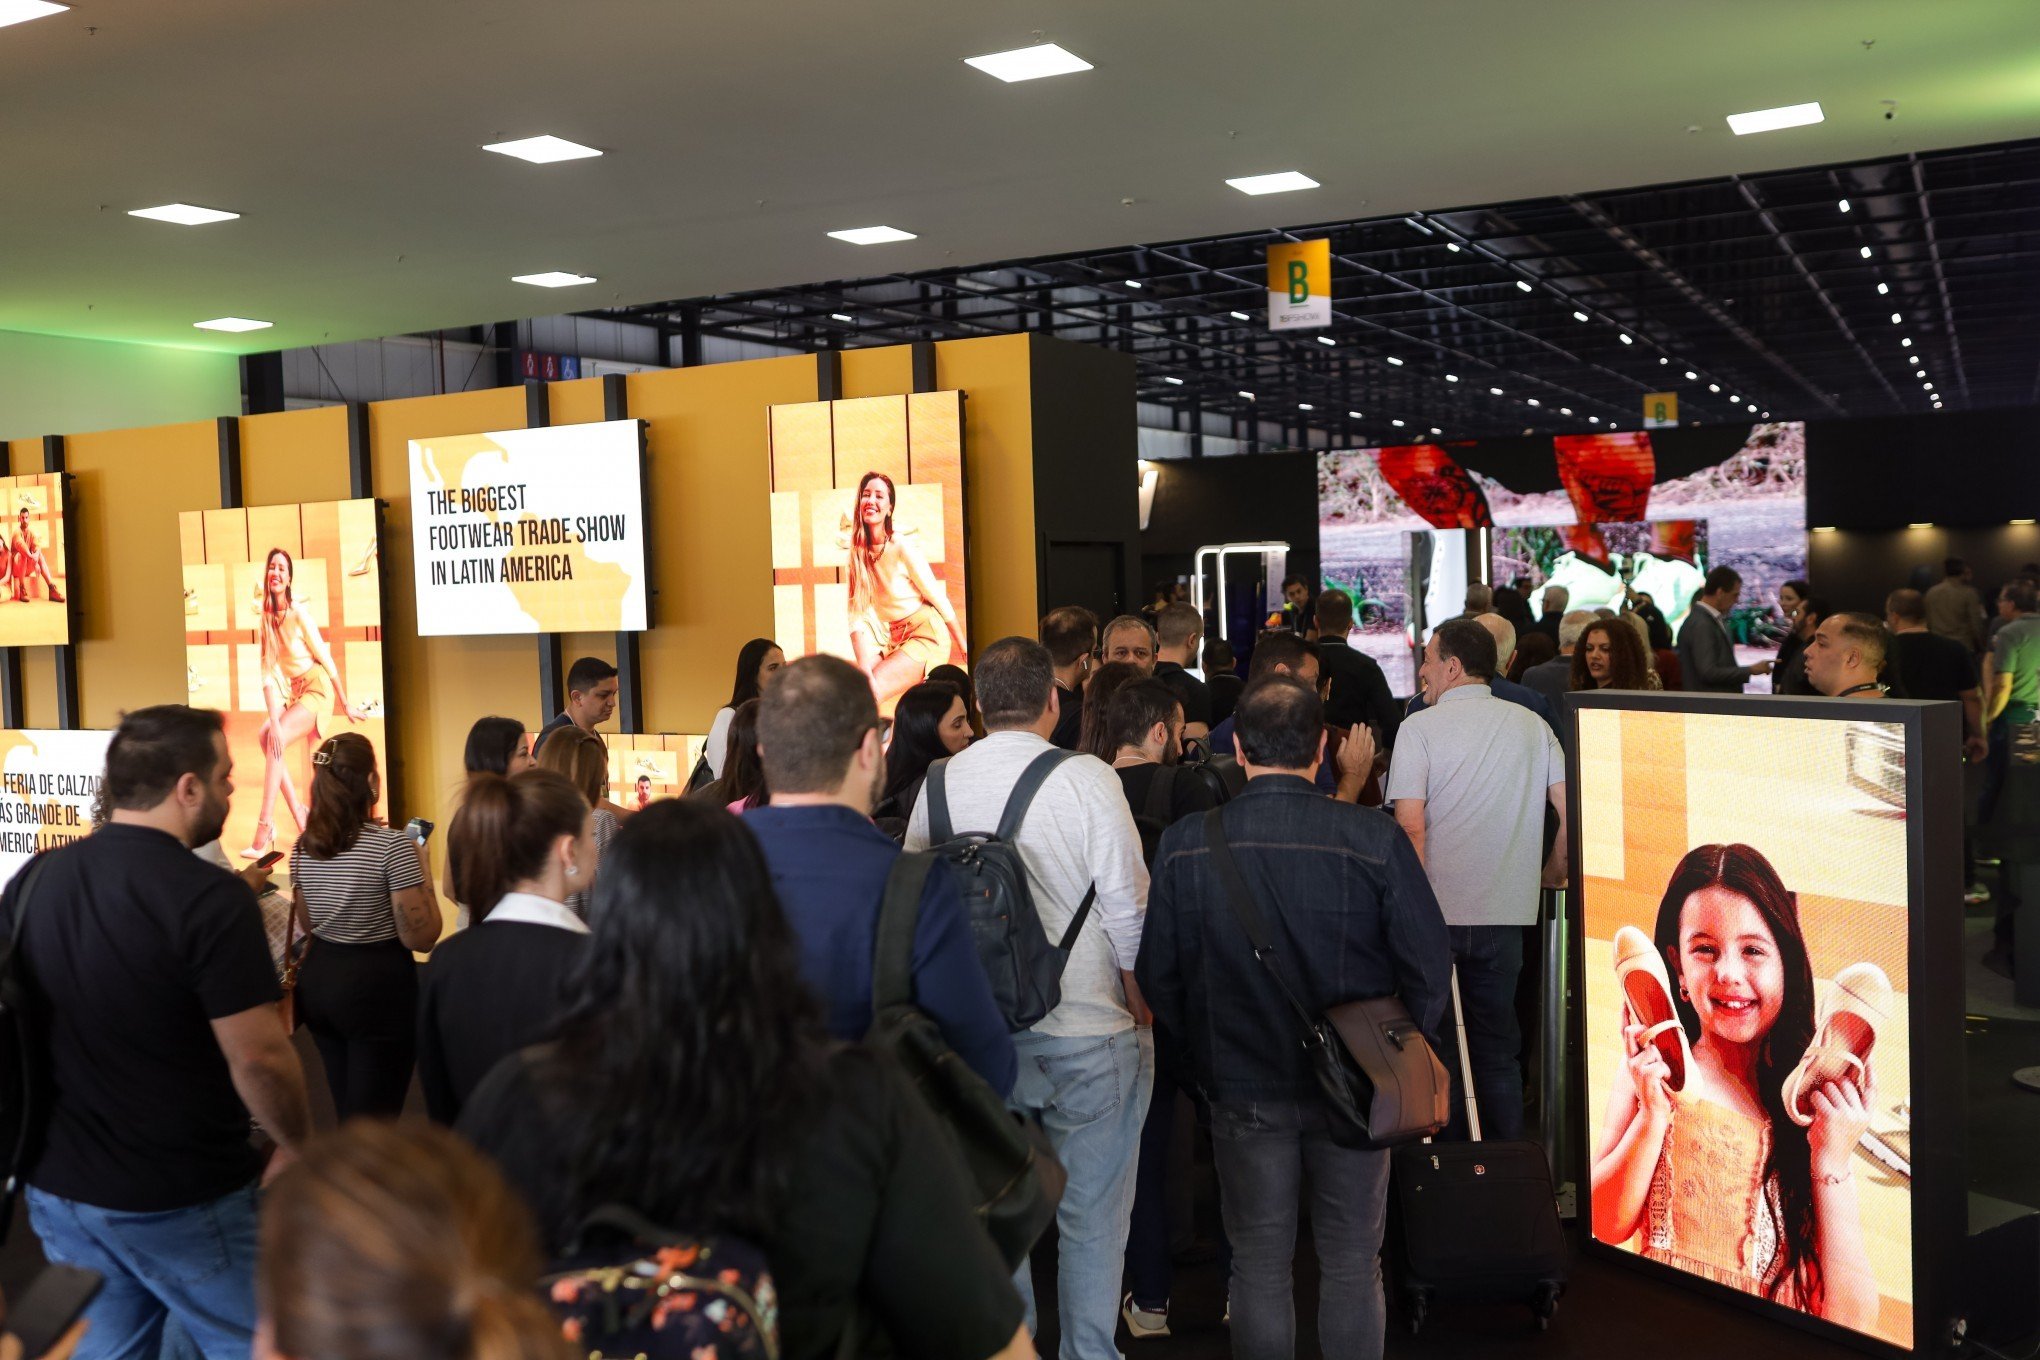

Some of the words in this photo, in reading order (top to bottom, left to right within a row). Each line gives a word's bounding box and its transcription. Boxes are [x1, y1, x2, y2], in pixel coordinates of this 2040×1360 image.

[1289, 260, 1309, 304] B
[427, 489, 457, 515] THE
[461, 484, 527, 513] BIGGEST
[430, 521, 514, 550] FOOTWEAR
[517, 518, 571, 546] TRADE
[576, 514, 625, 543] SHOW
[431, 560, 447, 586] IN
[451, 558, 495, 584] LATIN
[500, 554, 573, 582] AMERICA
[3, 773, 37, 795] FERIA
[39, 773, 55, 795] DE
[16, 802, 62, 826] GRANDE
[65, 804, 81, 827] DE
